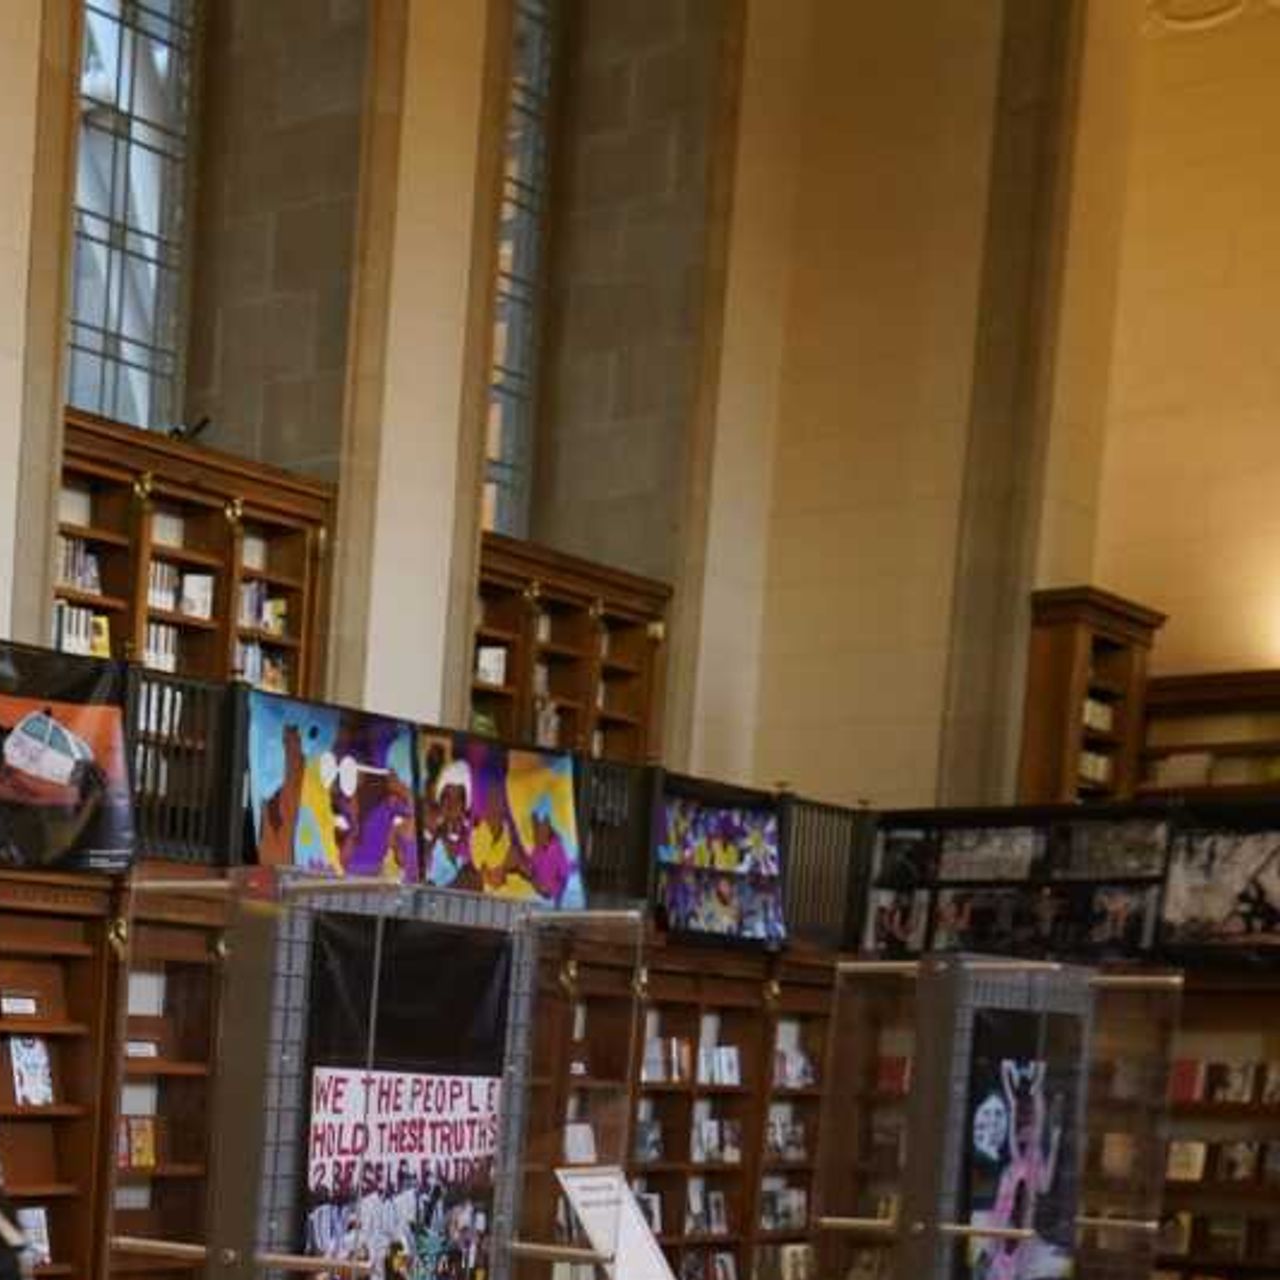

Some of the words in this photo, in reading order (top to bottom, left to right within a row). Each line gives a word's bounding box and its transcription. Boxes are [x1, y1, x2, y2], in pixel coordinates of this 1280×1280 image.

[313, 1075, 348, 1114] WE
[361, 1075, 404, 1114] THE
[410, 1078, 497, 1114] PEOPLE
[310, 1121, 369, 1160] HOLD
[378, 1117, 425, 1154] THESE
[427, 1114, 498, 1156] TRUTHS
